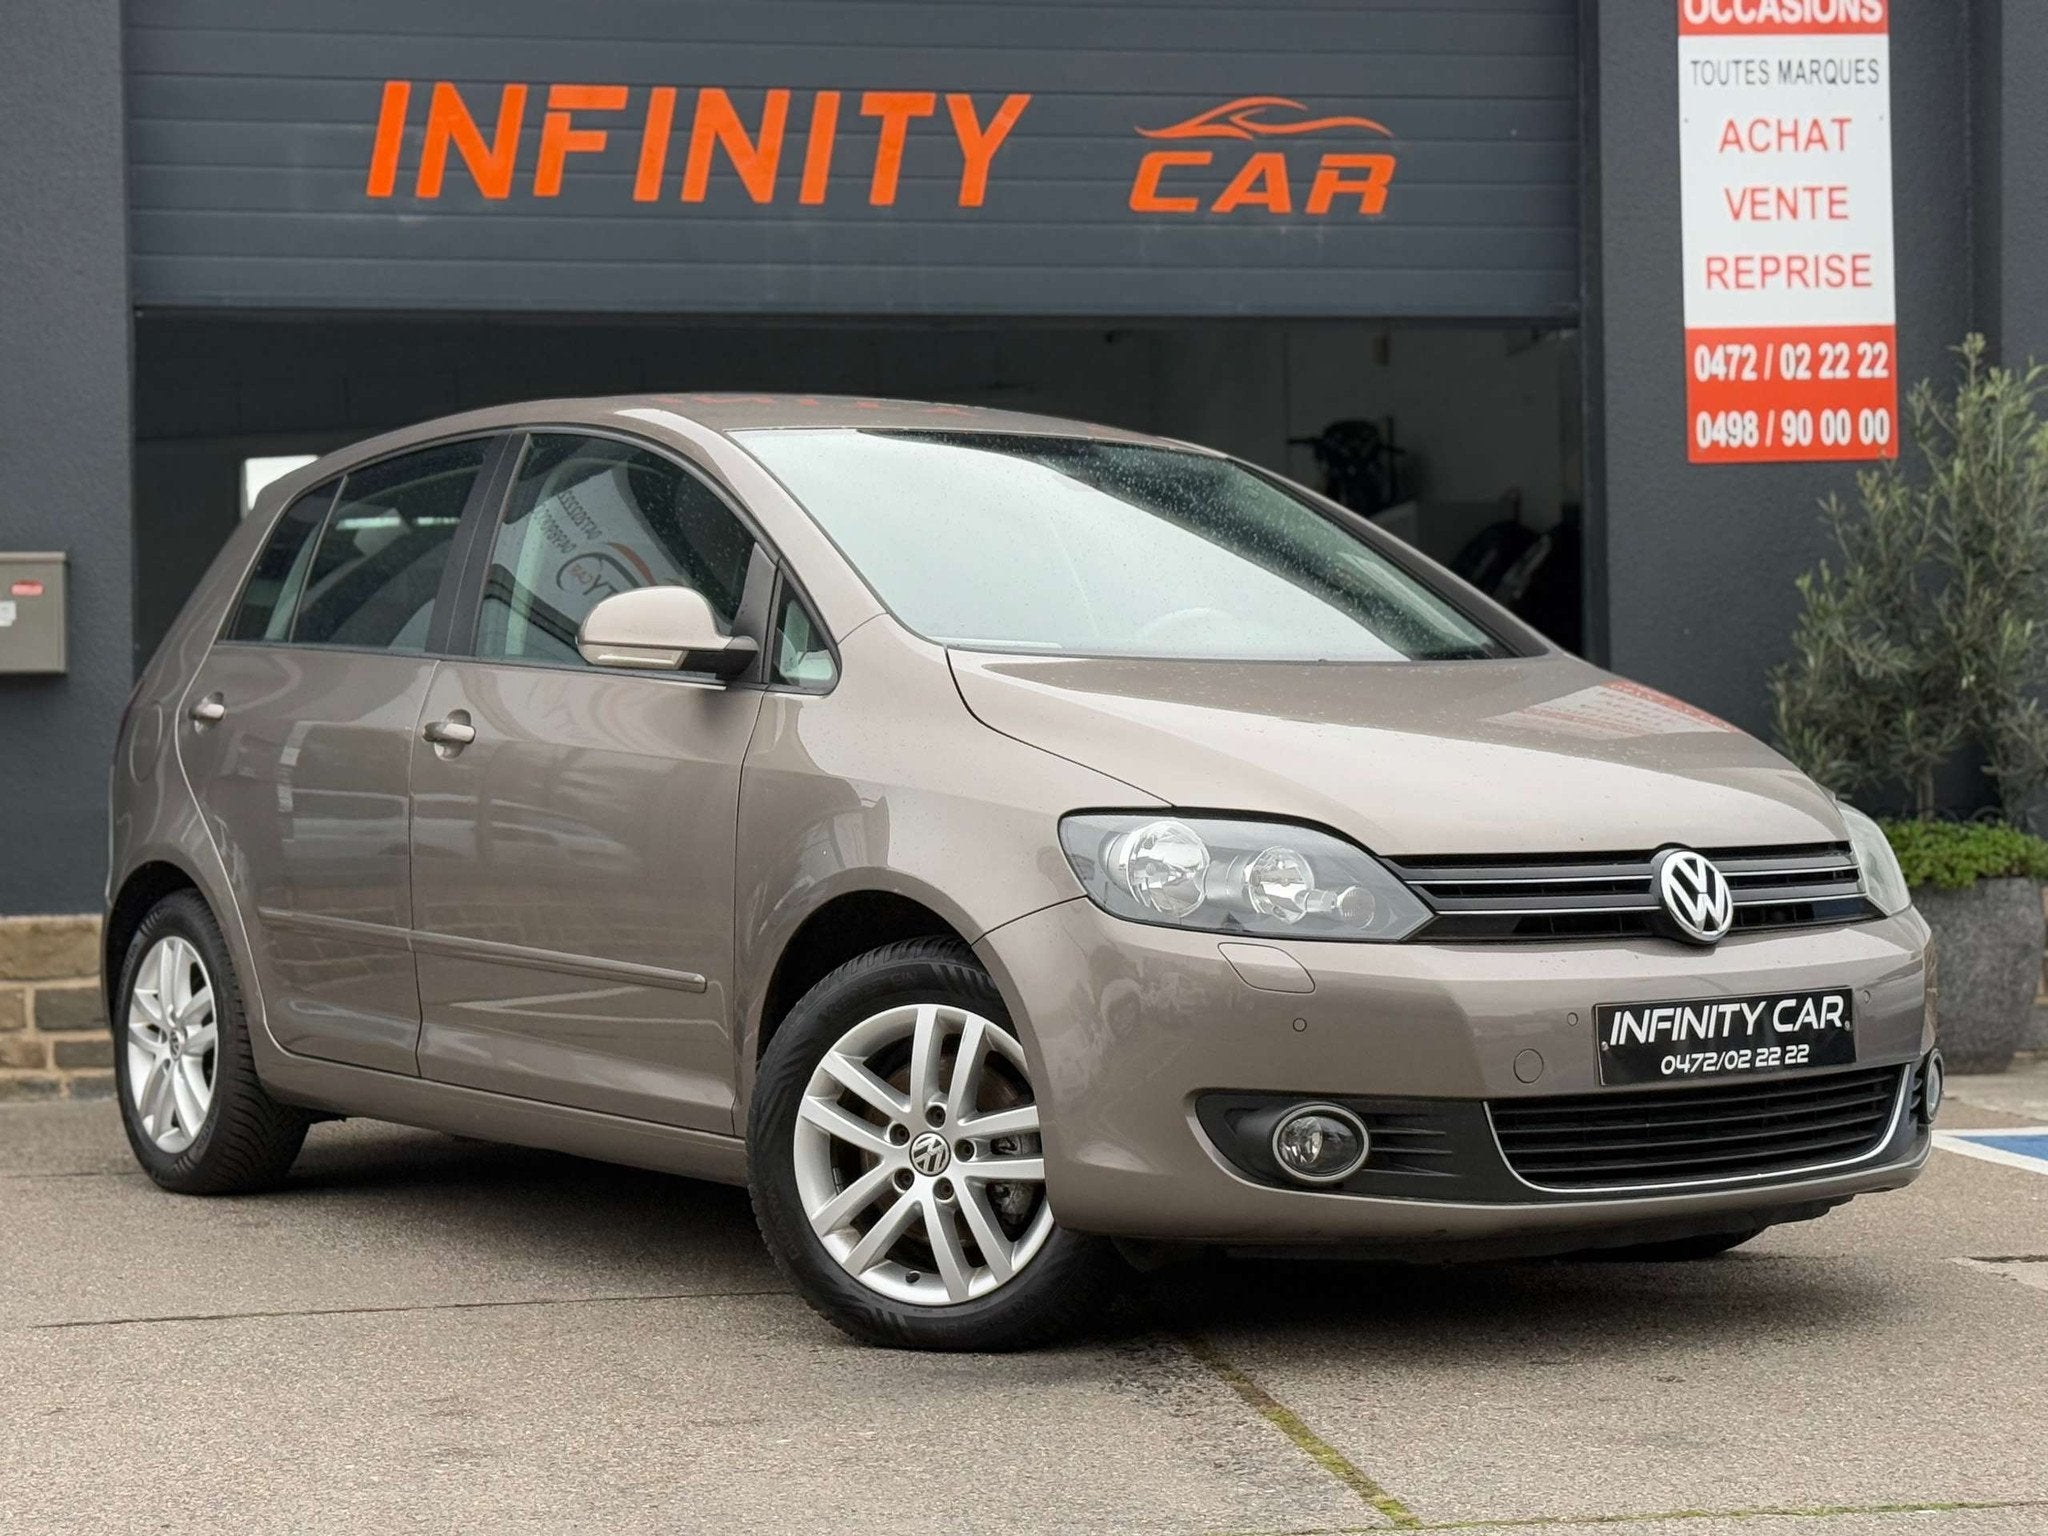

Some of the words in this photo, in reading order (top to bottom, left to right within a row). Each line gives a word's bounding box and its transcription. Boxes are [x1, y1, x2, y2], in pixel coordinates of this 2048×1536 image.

[1691, 59, 1770, 85] TOUTES
[1778, 58, 1880, 85] MARQUES
[366, 81, 1032, 206] INFINITY
[1129, 151, 1396, 214] CAR
[1719, 118, 1852, 153] ACHAT
[1724, 186, 1849, 221] VENTE
[1706, 254, 1872, 290] REPRISE
[1694, 344, 1758, 383] 0472
[1779, 342, 1812, 381] 02
[1818, 342, 1850, 380] 22
[1856, 341, 1889, 379] 22
[1696, 410, 1759, 449] 0498
[1781, 409, 1813, 447] 90
[1820, 408, 1851, 446] 00
[1858, 407, 1890, 446] 00
[1610, 1001, 1766, 1046] INFINITY
[1772, 995, 1844, 1033] CAR
[1661, 1050, 1751, 1075] 0472/02
[1755, 1046, 1781, 1068] 22
[1784, 1044, 1810, 1065] 22
